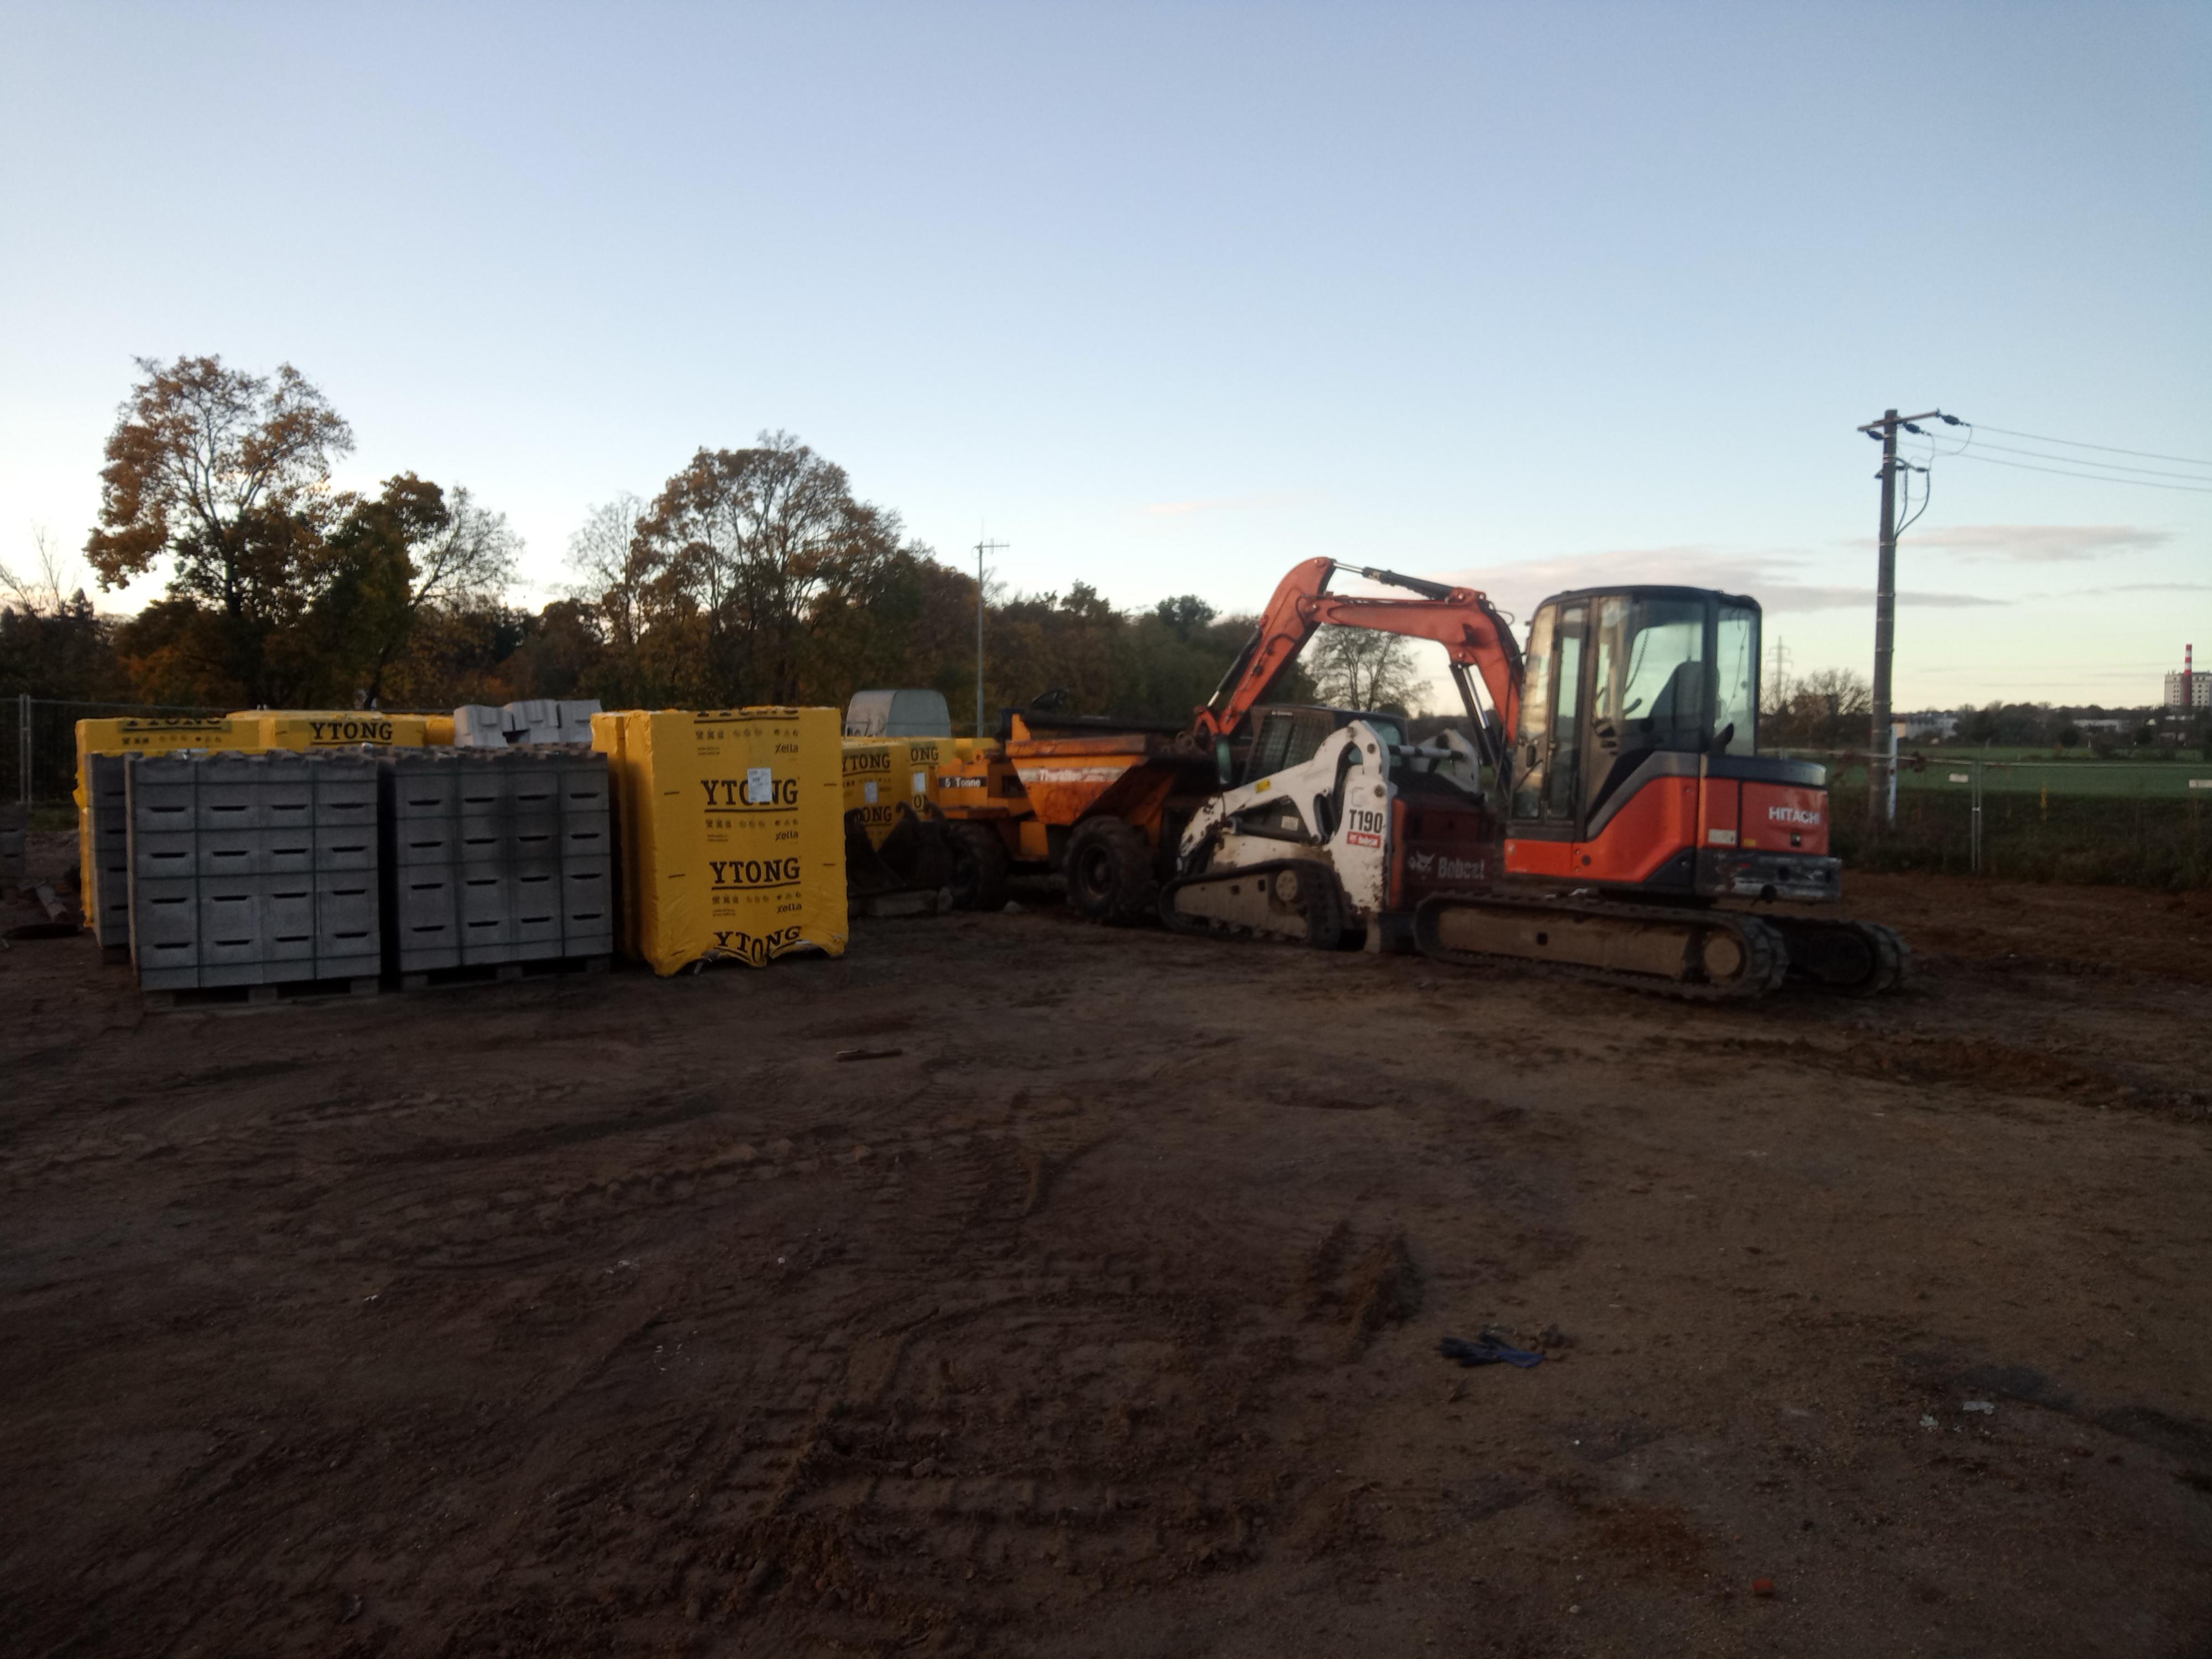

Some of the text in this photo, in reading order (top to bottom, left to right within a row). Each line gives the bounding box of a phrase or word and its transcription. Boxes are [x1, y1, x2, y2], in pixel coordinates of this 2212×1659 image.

[309, 722, 392, 740] YTONG
[911, 747, 938, 761] ONG
[945, 777, 981, 787] 5 Tonne
[862, 806, 893, 822] ONG
[1349, 809, 1383, 833] T190
[1769, 806, 1822, 825] HITACHI
[709, 857, 801, 884] YTONG
[1438, 857, 1485, 879] Bobcat
[713, 925, 803, 964] YTONG
